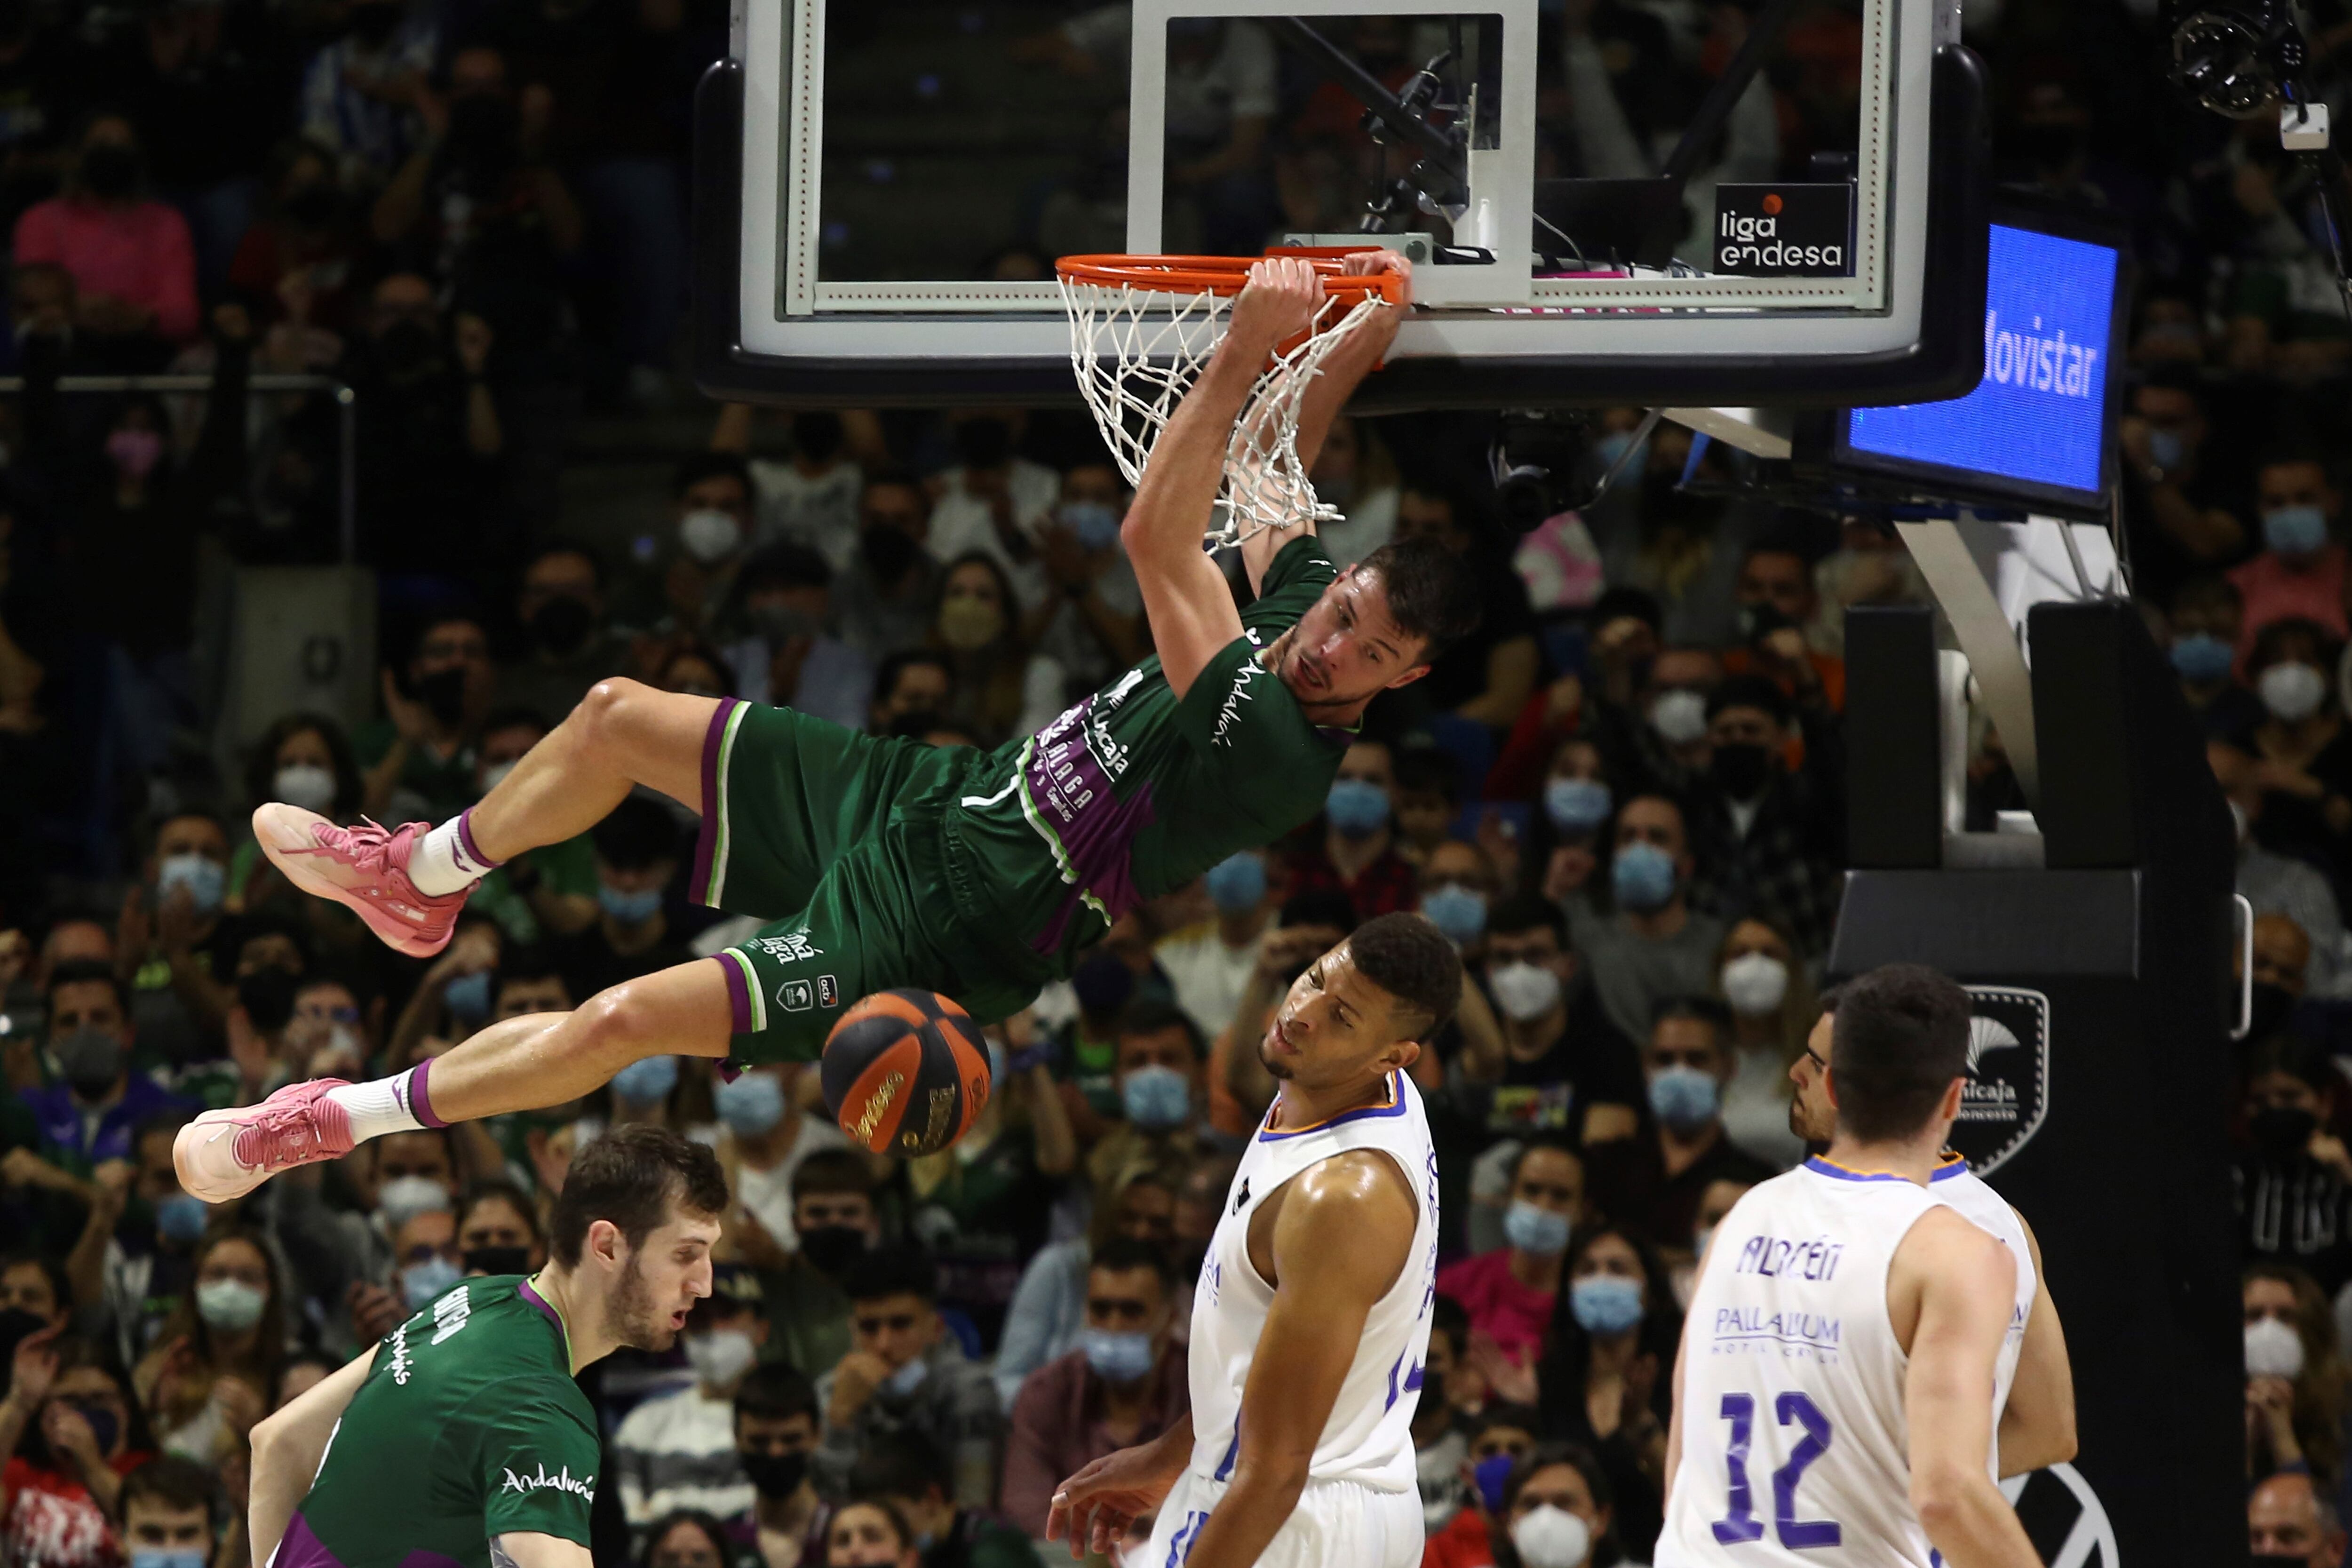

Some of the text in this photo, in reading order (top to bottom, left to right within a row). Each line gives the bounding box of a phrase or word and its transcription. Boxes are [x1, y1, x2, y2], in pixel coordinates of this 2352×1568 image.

[1721, 210, 1776, 242] liga
[1720, 239, 1842, 267] endesa
[1984, 310, 2097, 398] ovistar
[1047, 741, 1094, 809] ÁLAGA
[820, 979, 831, 1001] acb
[1962, 1078, 2017, 1106] nicaja
[1712, 1391, 1842, 1550] 12
